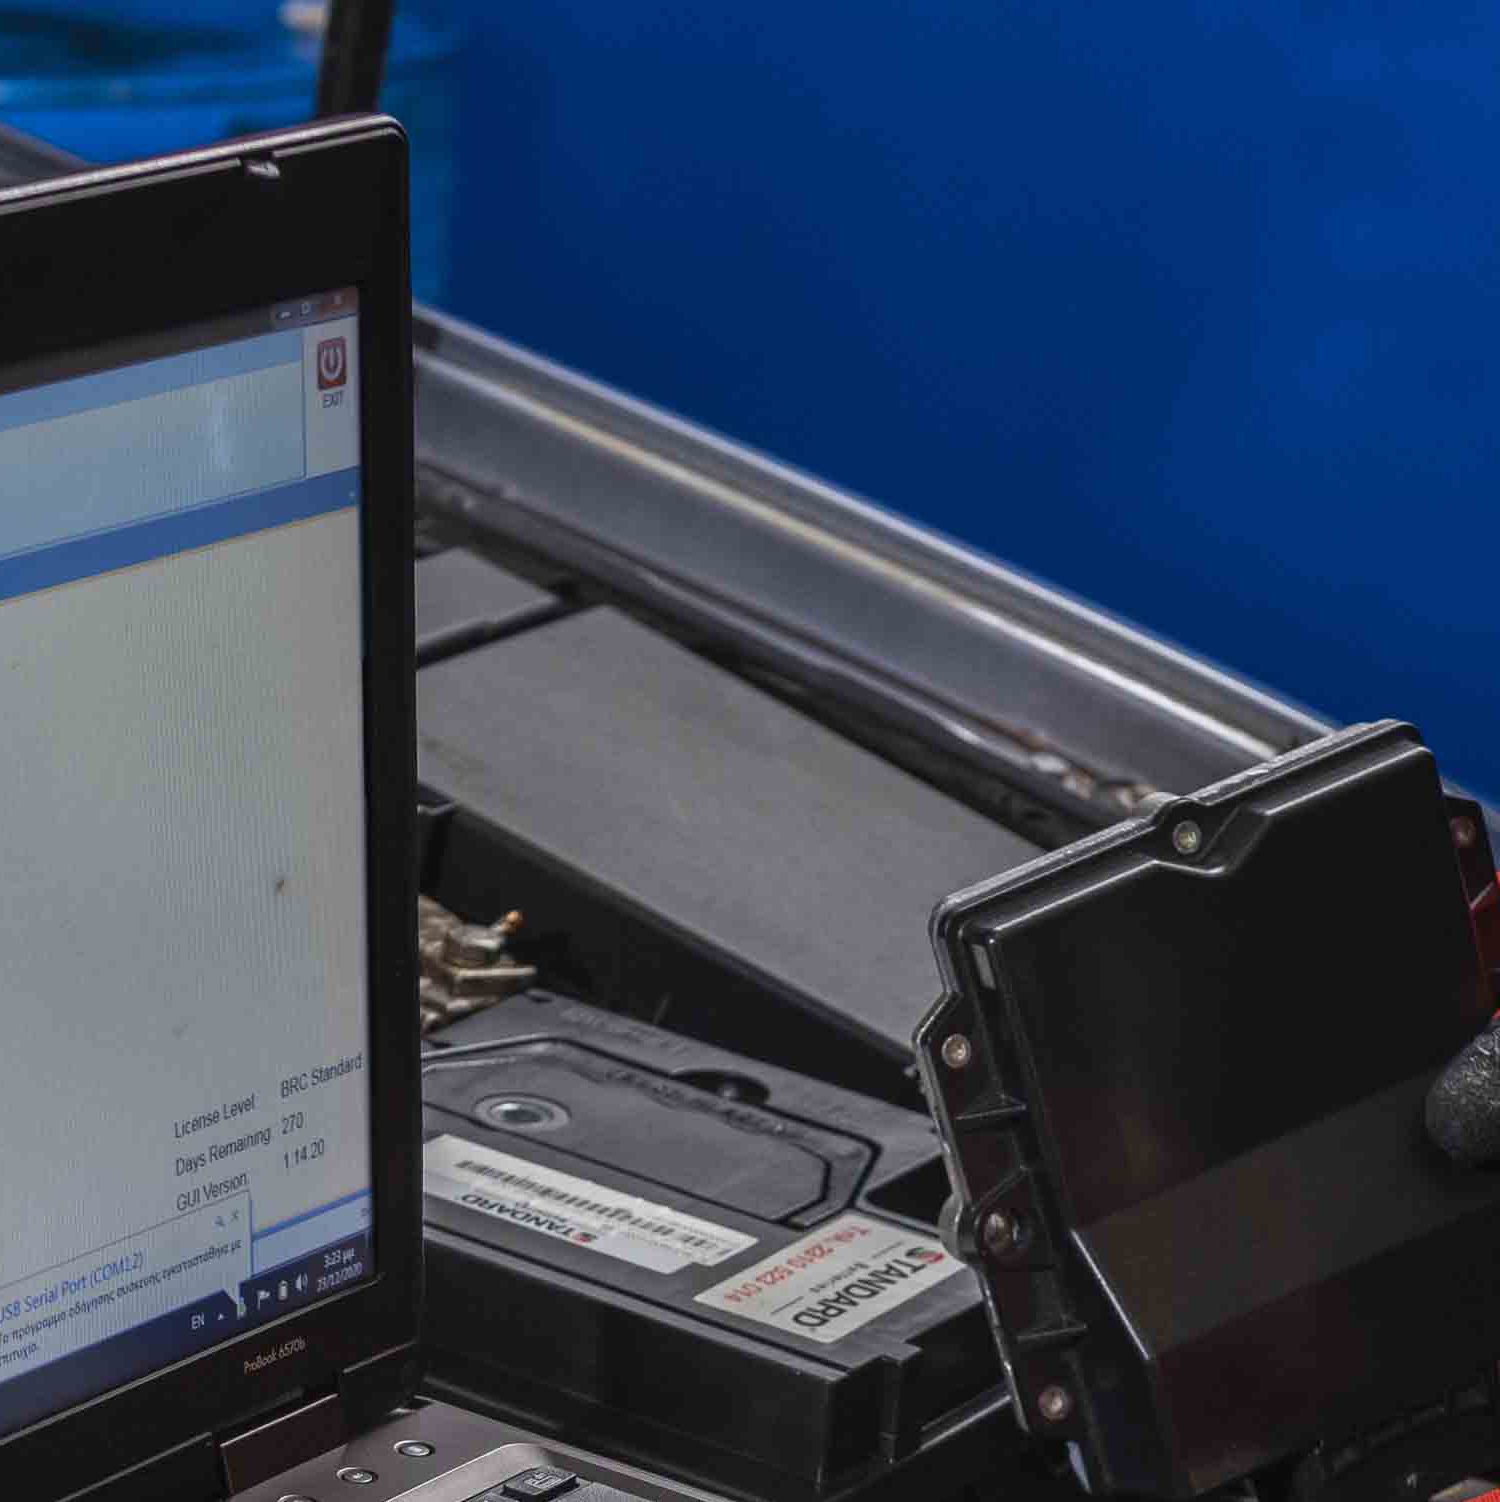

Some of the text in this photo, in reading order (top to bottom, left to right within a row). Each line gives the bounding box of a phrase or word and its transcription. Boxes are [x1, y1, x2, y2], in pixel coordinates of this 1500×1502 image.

[174, 1108, 220, 1139] License
[280, 1073, 309, 1099] BRC
[311, 1052, 364, 1086] Standard
[175, 1153, 206, 1177] Days
[281, 1111, 304, 1135] 270
[176, 1188, 200, 1212] GUI
[461, 1191, 599, 1245] STANDARD
[24, 1284, 59, 1313] Serial
[61, 1275, 88, 1297] Port
[792, 1245, 945, 1330] STANDARD
[243, 1348, 279, 1375] ProBook
